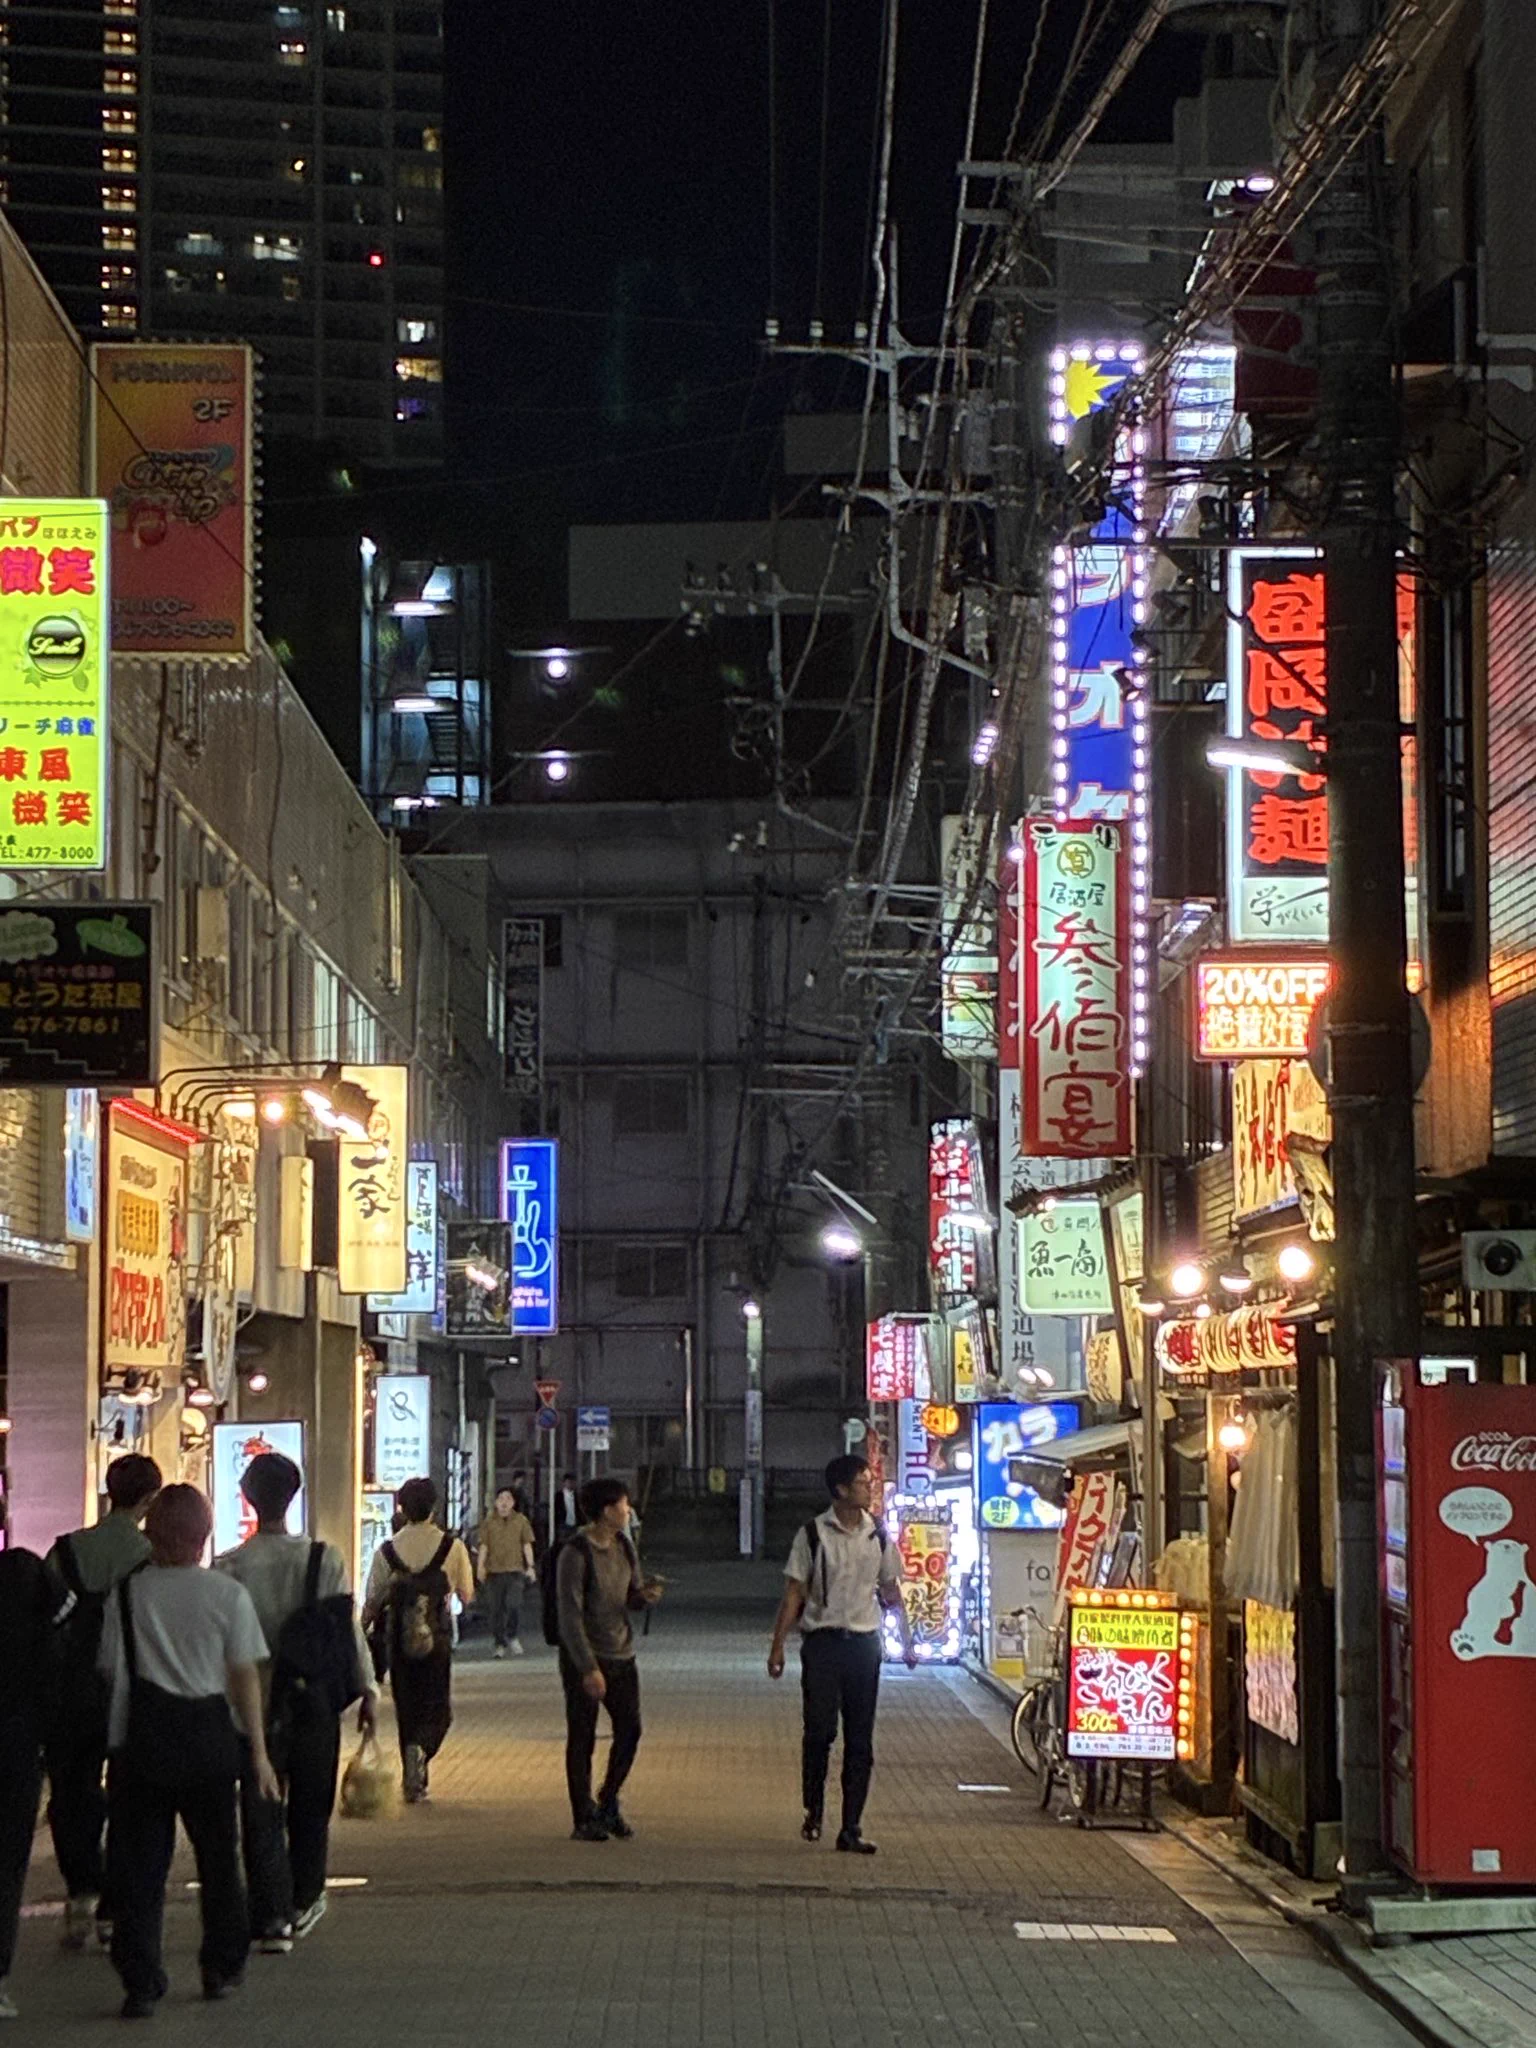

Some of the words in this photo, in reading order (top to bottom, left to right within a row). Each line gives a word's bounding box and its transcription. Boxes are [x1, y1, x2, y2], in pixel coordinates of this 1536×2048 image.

[193, 398, 235, 423] 2F
[0, 546, 95, 595] 微笑
[0, 747, 71, 781] 東風
[12, 790, 92, 826] 微笑
[0, 846, 94, 859] EL:477-8000
[1049, 882, 1106, 908] 居酒屋
[1205, 967, 1329, 1005] 20%OFF
